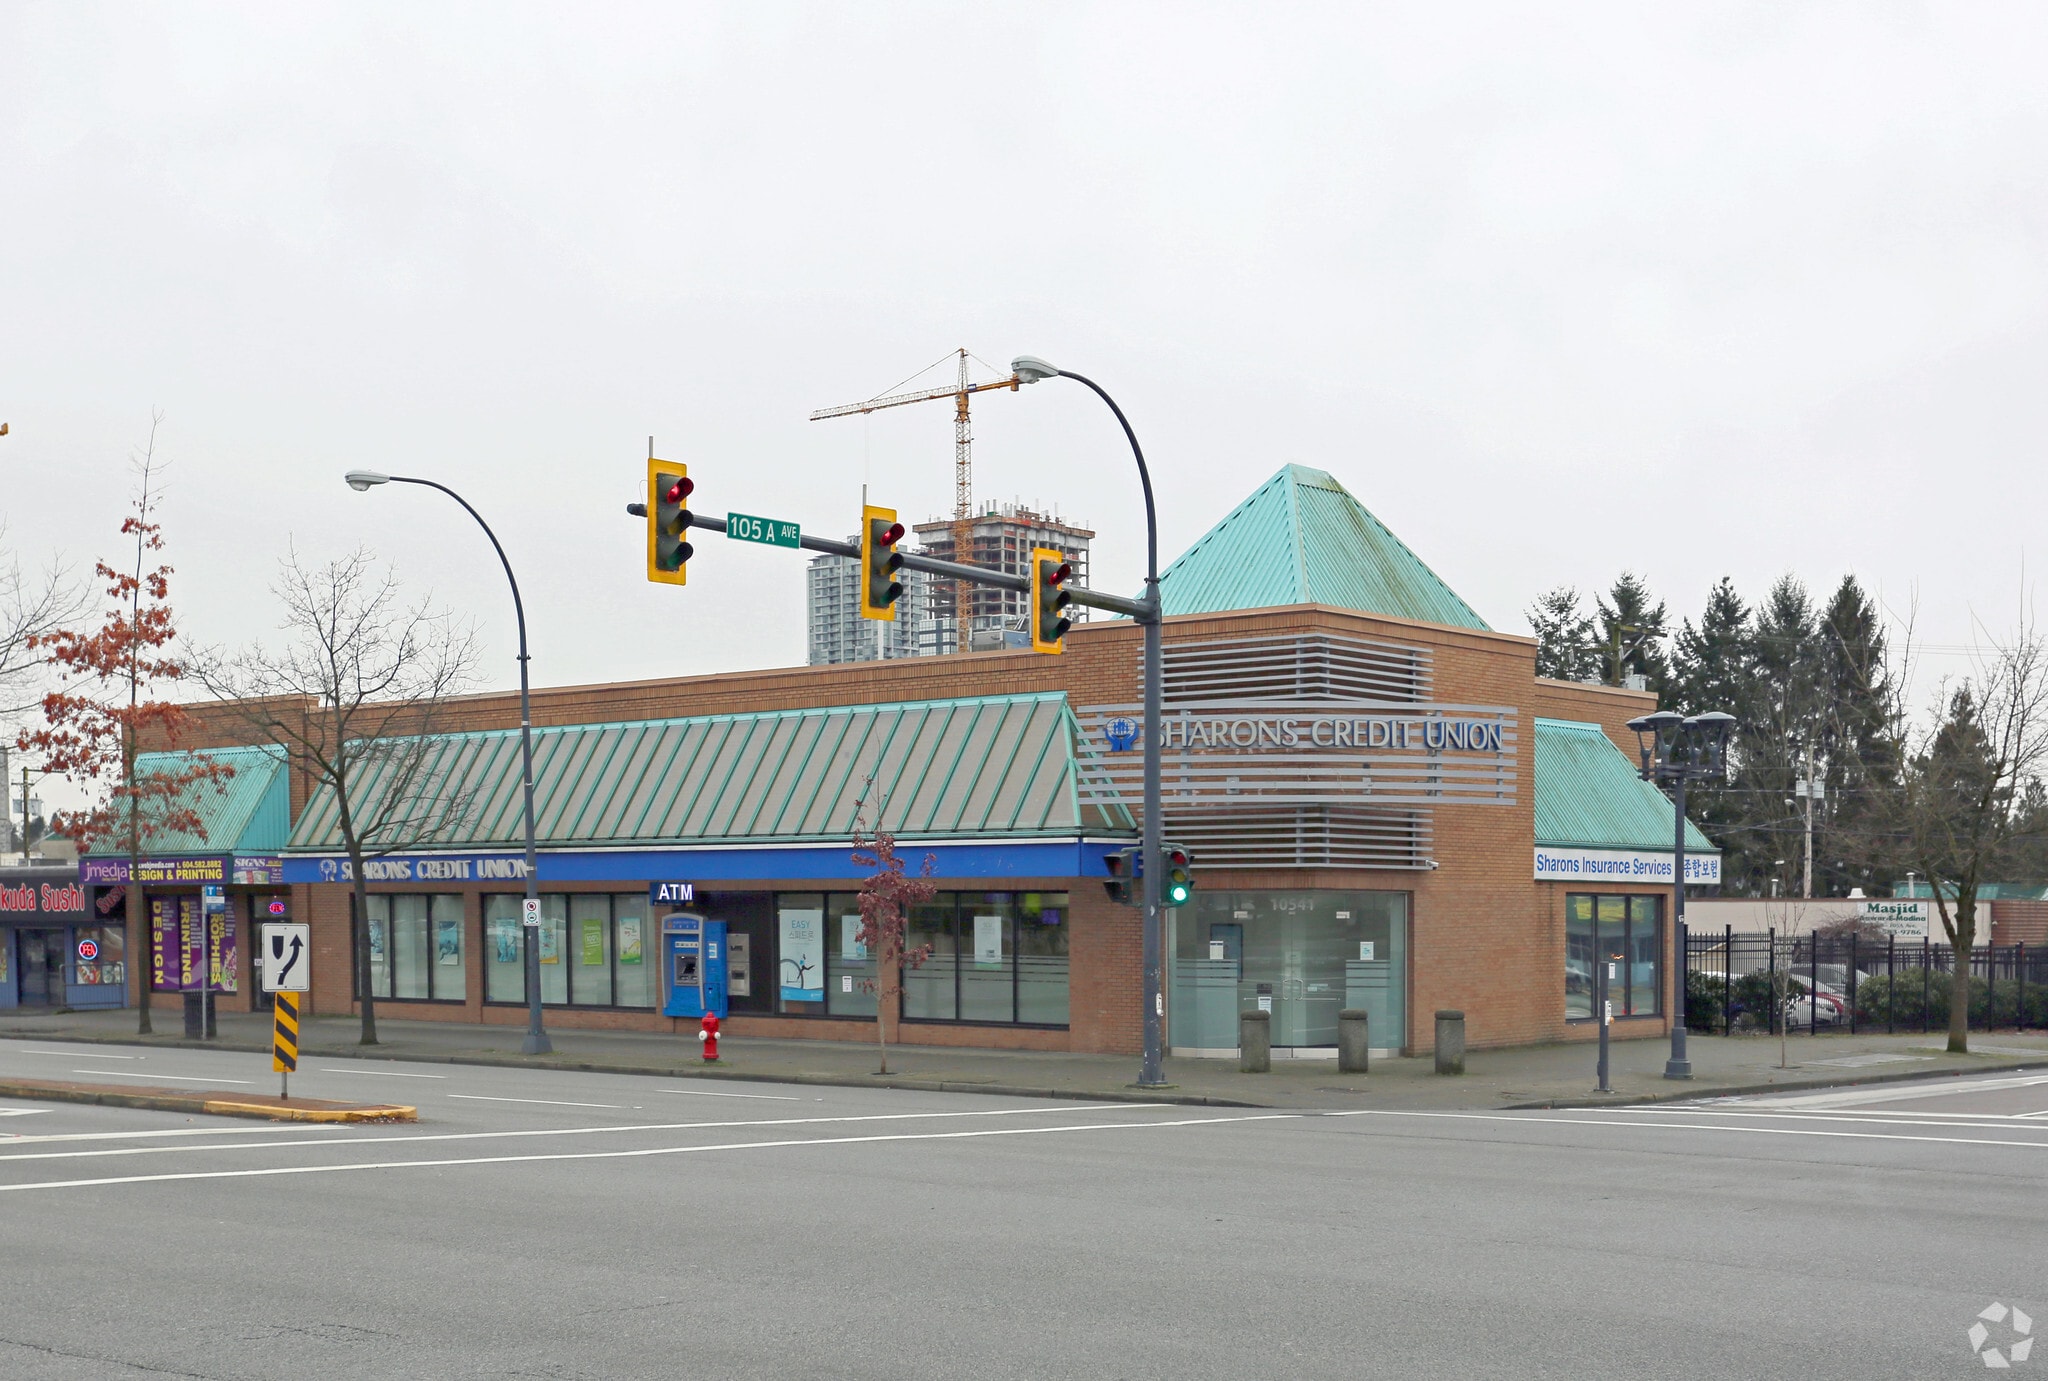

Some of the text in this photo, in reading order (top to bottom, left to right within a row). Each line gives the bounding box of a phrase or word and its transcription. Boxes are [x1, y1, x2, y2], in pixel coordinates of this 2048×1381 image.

[731, 516, 797, 542] 105 A AVE
[1160, 718, 1503, 751] HARONS CREDIT UNION
[84, 862, 128, 881] jmedia
[233, 858, 265, 867] SIGNS
[340, 858, 528, 880] SARONS CREDIT UNION
[1536, 853, 1672, 876] Sharons Insurance Services
[1684, 858, 1718, 879] 종합보험
[166, 870, 174, 880] &
[176, 868, 223, 880] PRINTING
[41, 882, 85, 911] Sushi
[658, 883, 693, 900] ATM
[1270, 898, 1314, 911] 10541
[1867, 903, 1918, 915] Masjid
[791, 920, 810, 929] EASY
[153, 901, 164, 984] DESIGN
[181, 901, 192, 985] PRINTING
[210, 914, 221, 984] ROPHIES
